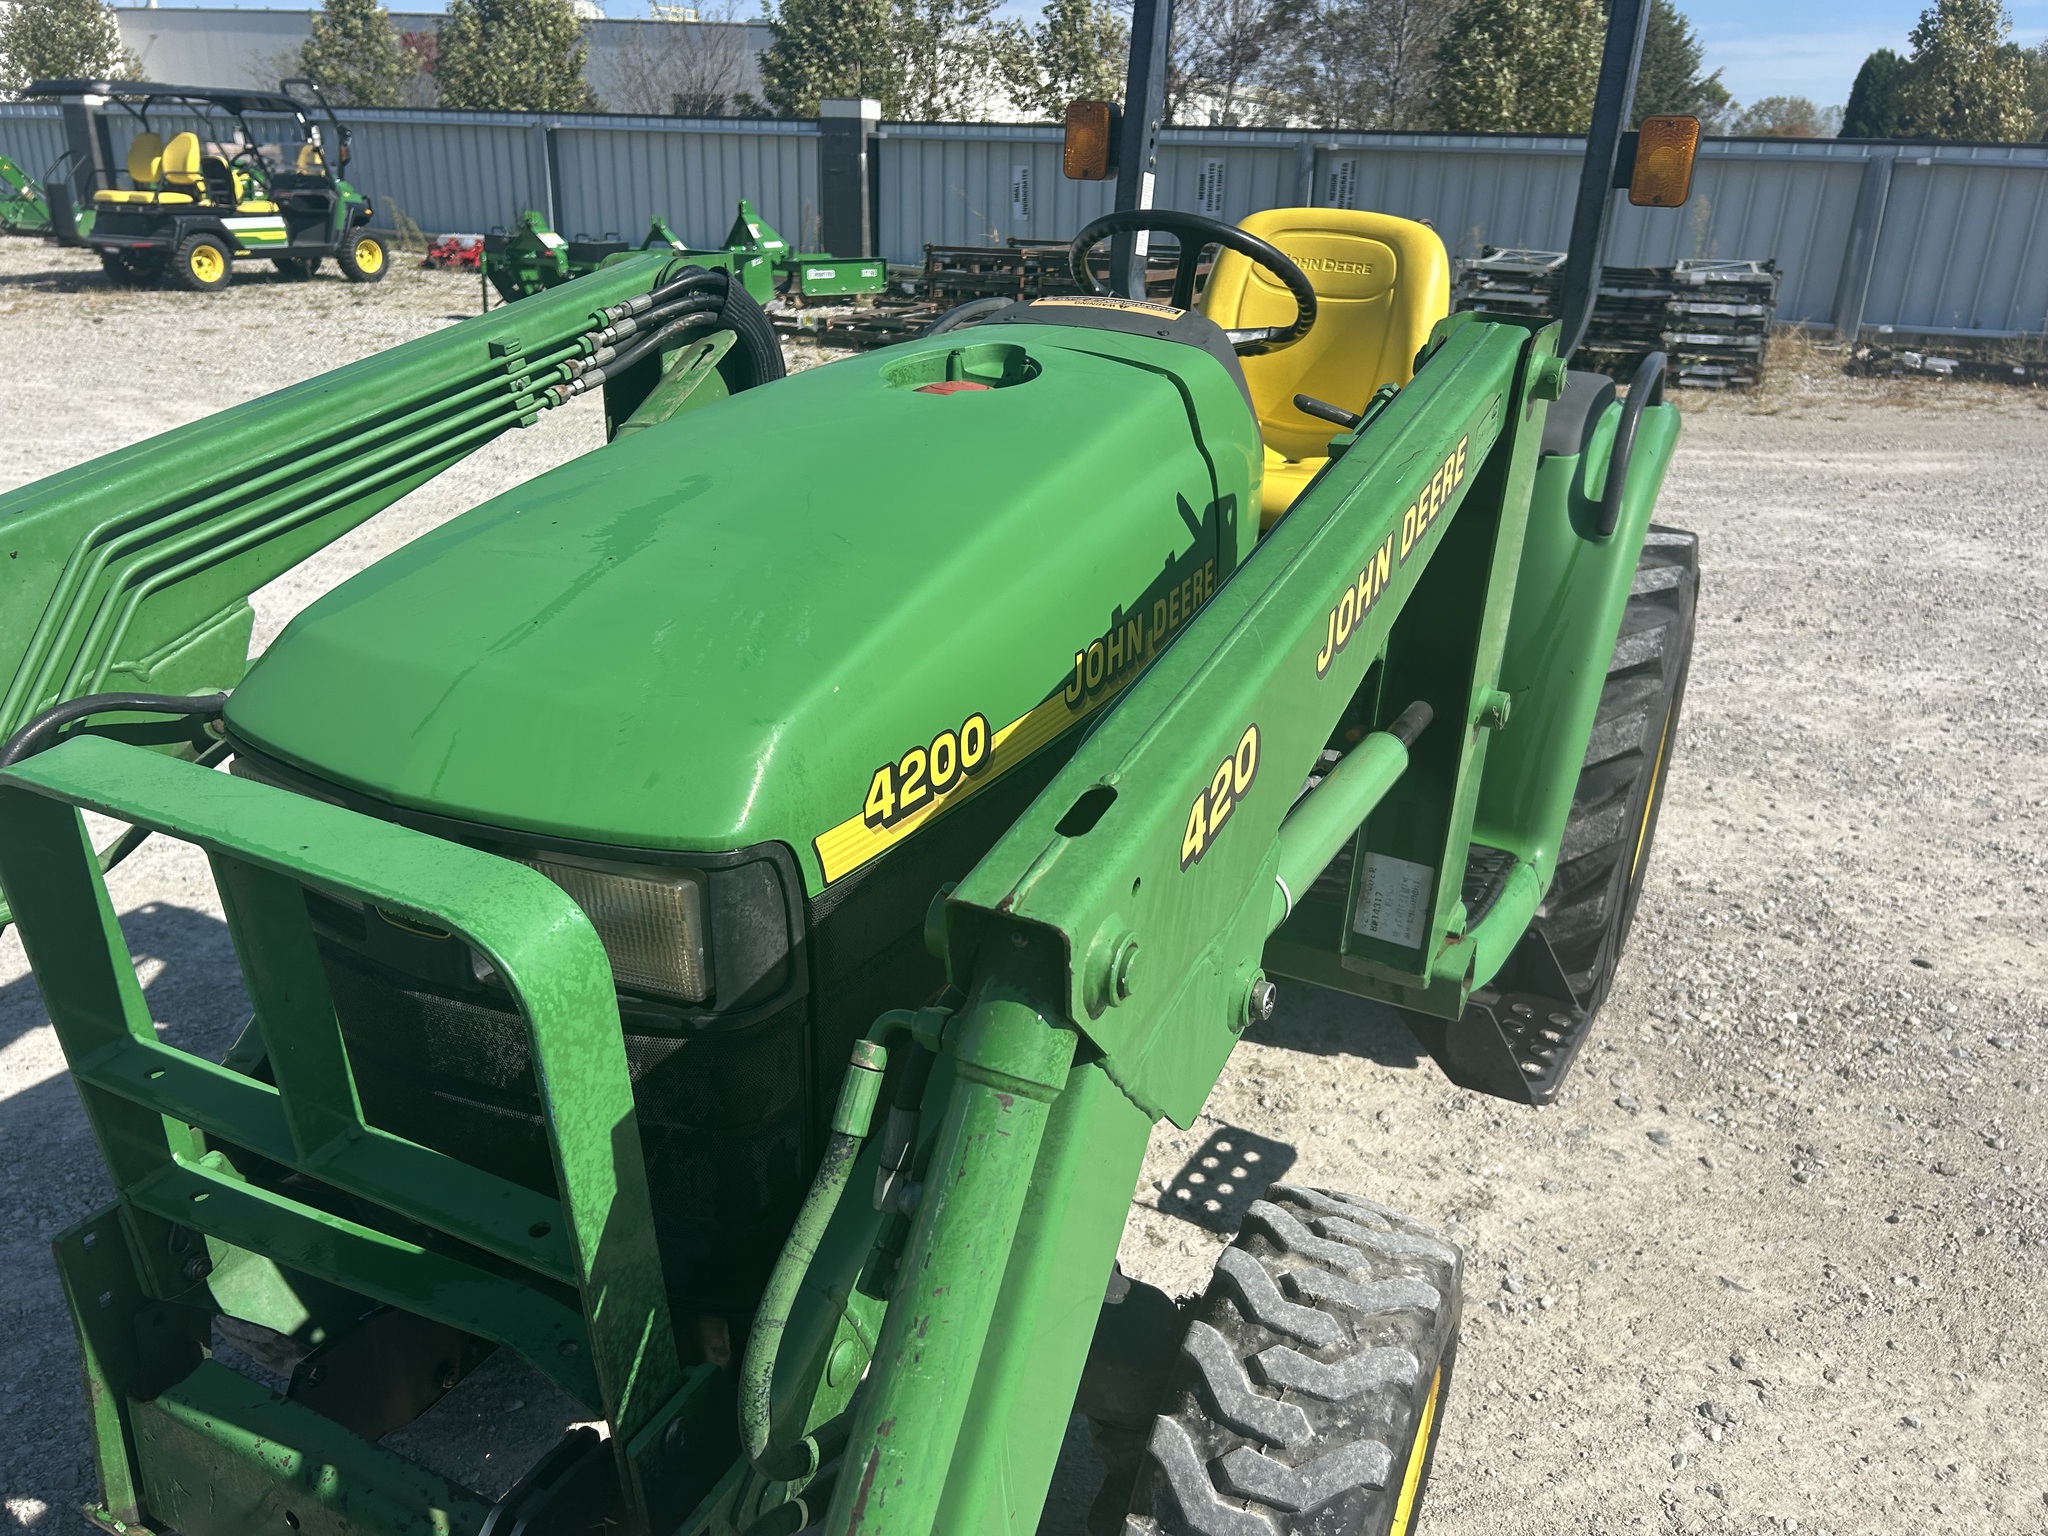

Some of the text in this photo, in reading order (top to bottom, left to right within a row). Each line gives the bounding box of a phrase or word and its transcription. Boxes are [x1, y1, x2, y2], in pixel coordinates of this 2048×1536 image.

[1198, 173, 1206, 200] MEDIUM
[1206, 162, 1216, 211] ENVIROCRATES
[1329, 173, 1338, 201] MEDIUM
[1338, 162, 1349, 209] NVIROCRATES
[1322, 258, 1374, 275] DEERE
[1073, 300, 1117, 309] WARNING
[1316, 433, 1469, 678] JOHN DEERE
[1065, 557, 1215, 708] JOHN DEERE
[863, 712, 991, 829] 4200
[1180, 722, 1261, 872] 420
